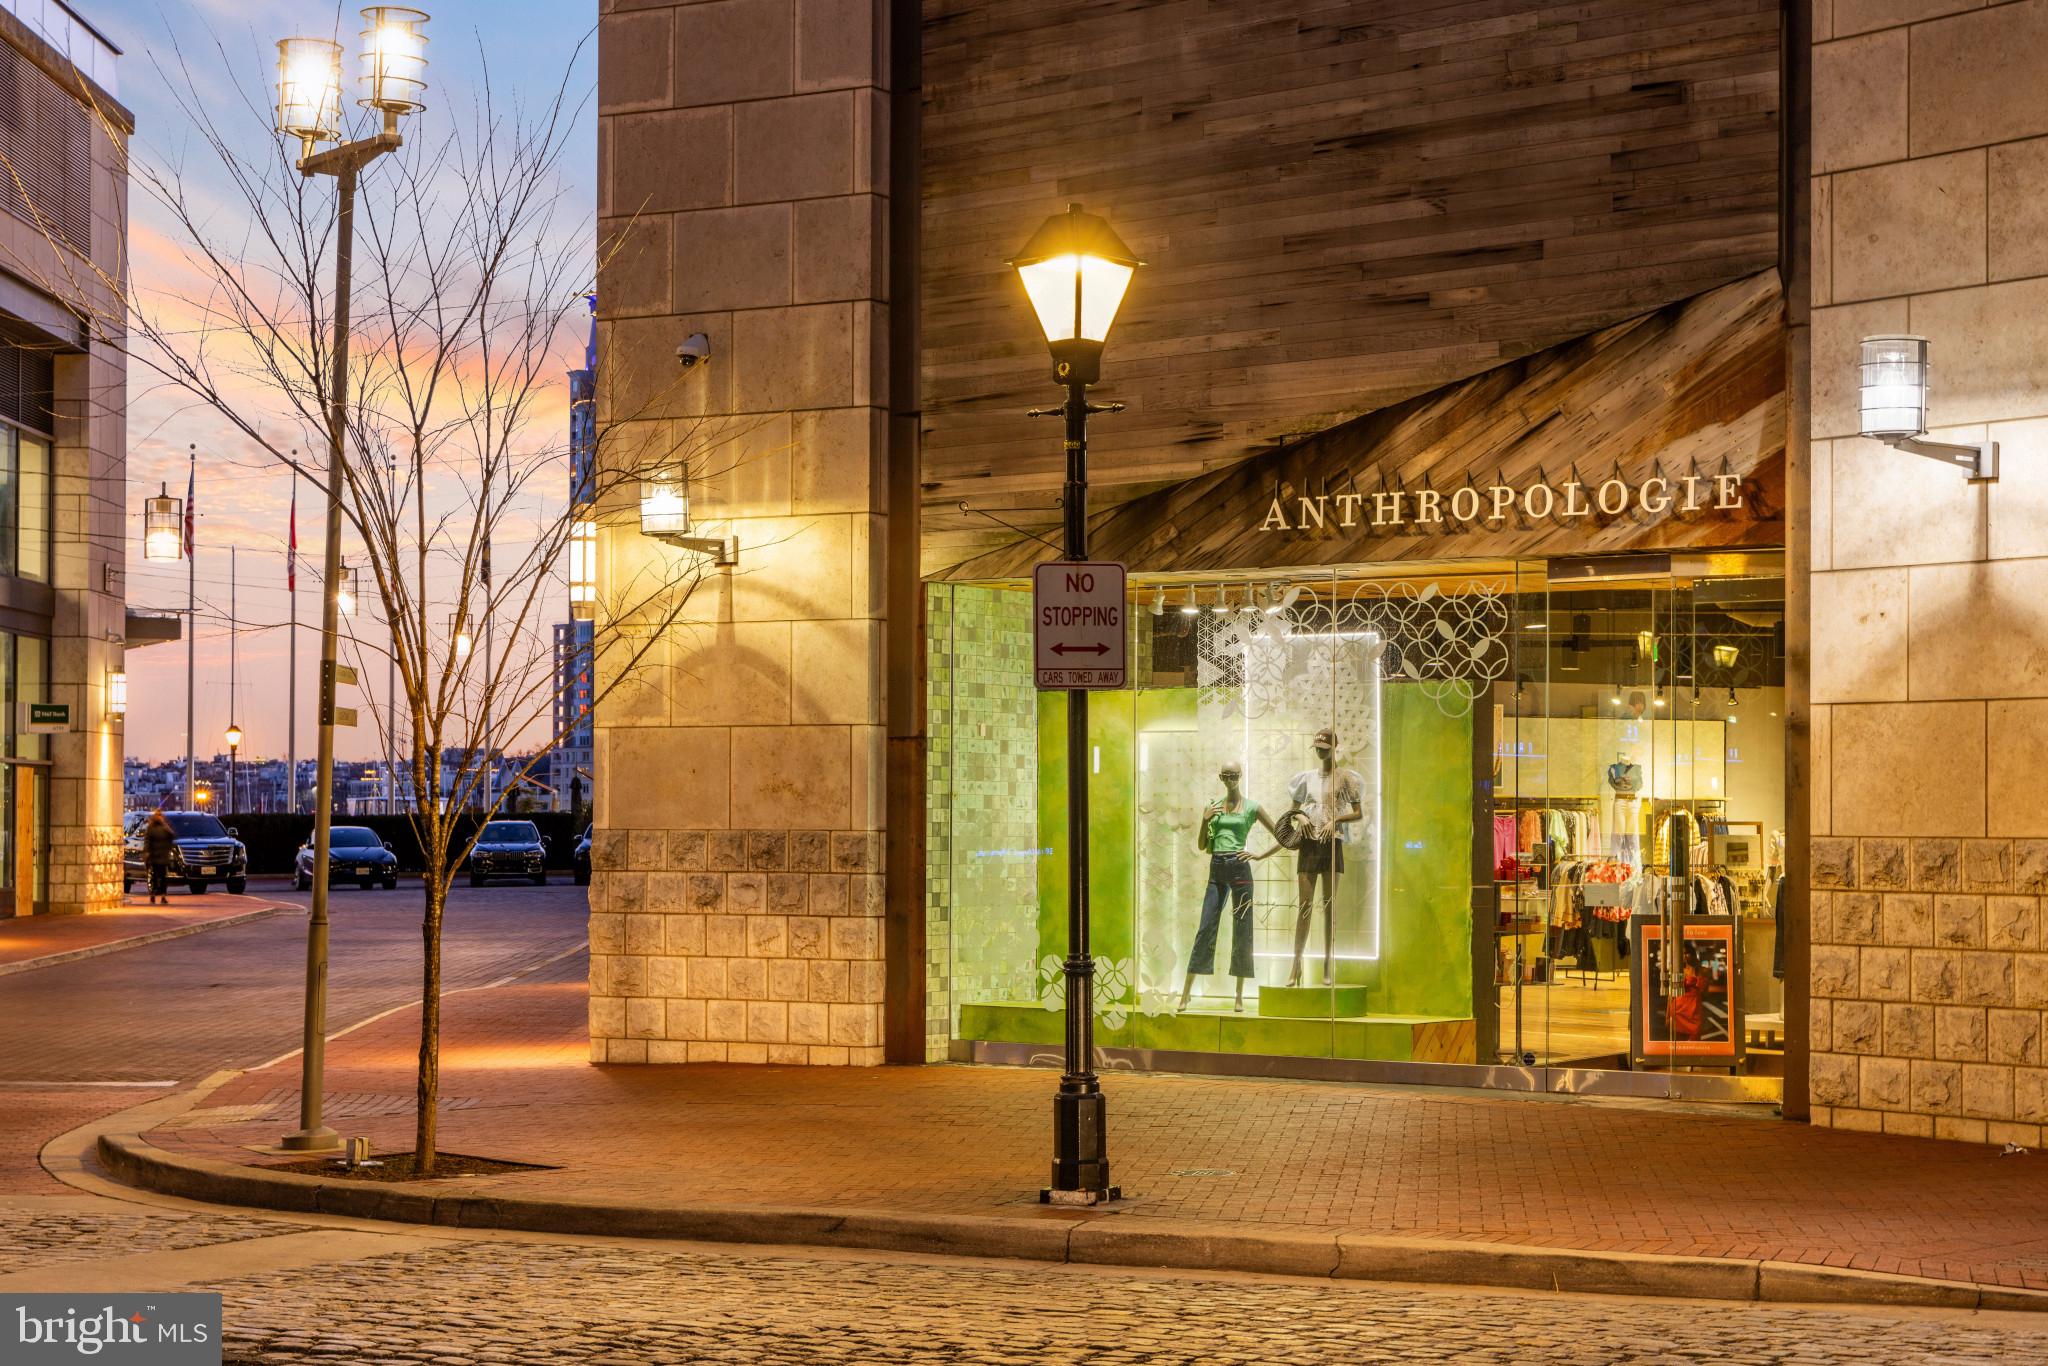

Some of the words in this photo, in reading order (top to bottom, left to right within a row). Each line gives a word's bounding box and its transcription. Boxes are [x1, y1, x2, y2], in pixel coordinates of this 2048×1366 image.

[1258, 473, 1743, 532] ANTHROPOLOGIE
[1066, 573, 1095, 593] NO
[1042, 606, 1118, 627] STOPPING
[1042, 671, 1063, 684] CARS
[1068, 671, 1093, 684] TOWED
[1098, 671, 1119, 684] AWAY
